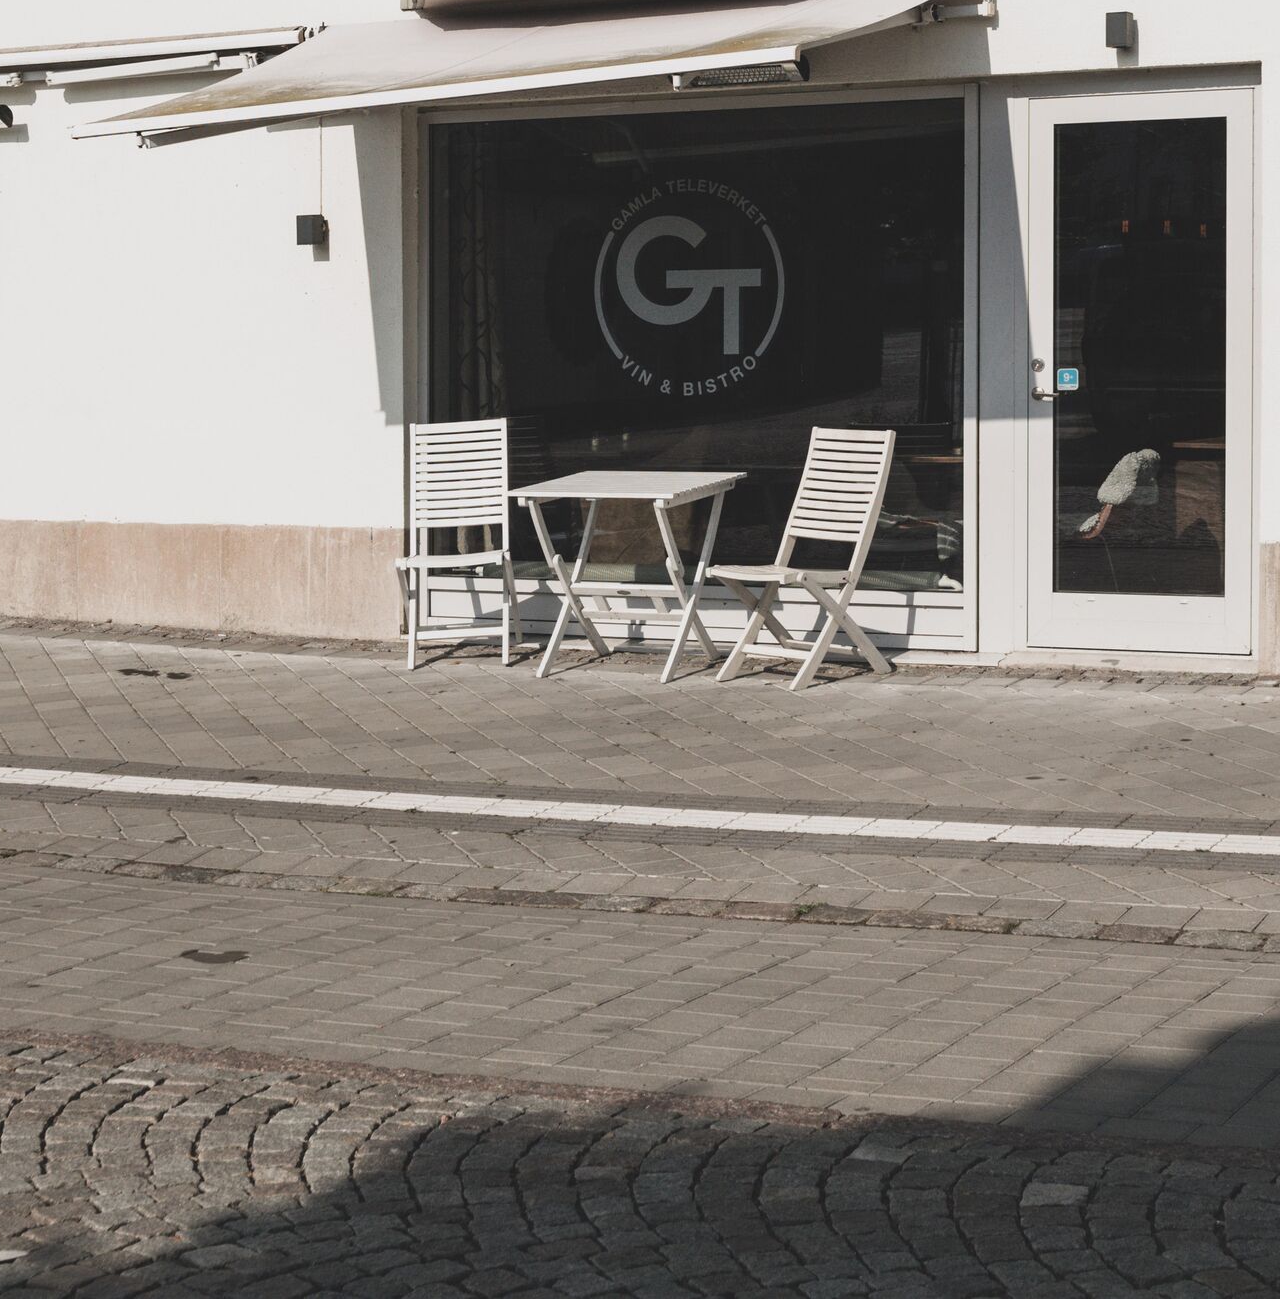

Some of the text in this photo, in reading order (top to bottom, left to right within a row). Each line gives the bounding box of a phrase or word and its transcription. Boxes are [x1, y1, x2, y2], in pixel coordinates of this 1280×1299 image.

[611, 178, 767, 231] GAMLA TELEVERKET
[616, 215, 762, 356] GT
[621, 355, 757, 396] VIN & BISTRO
